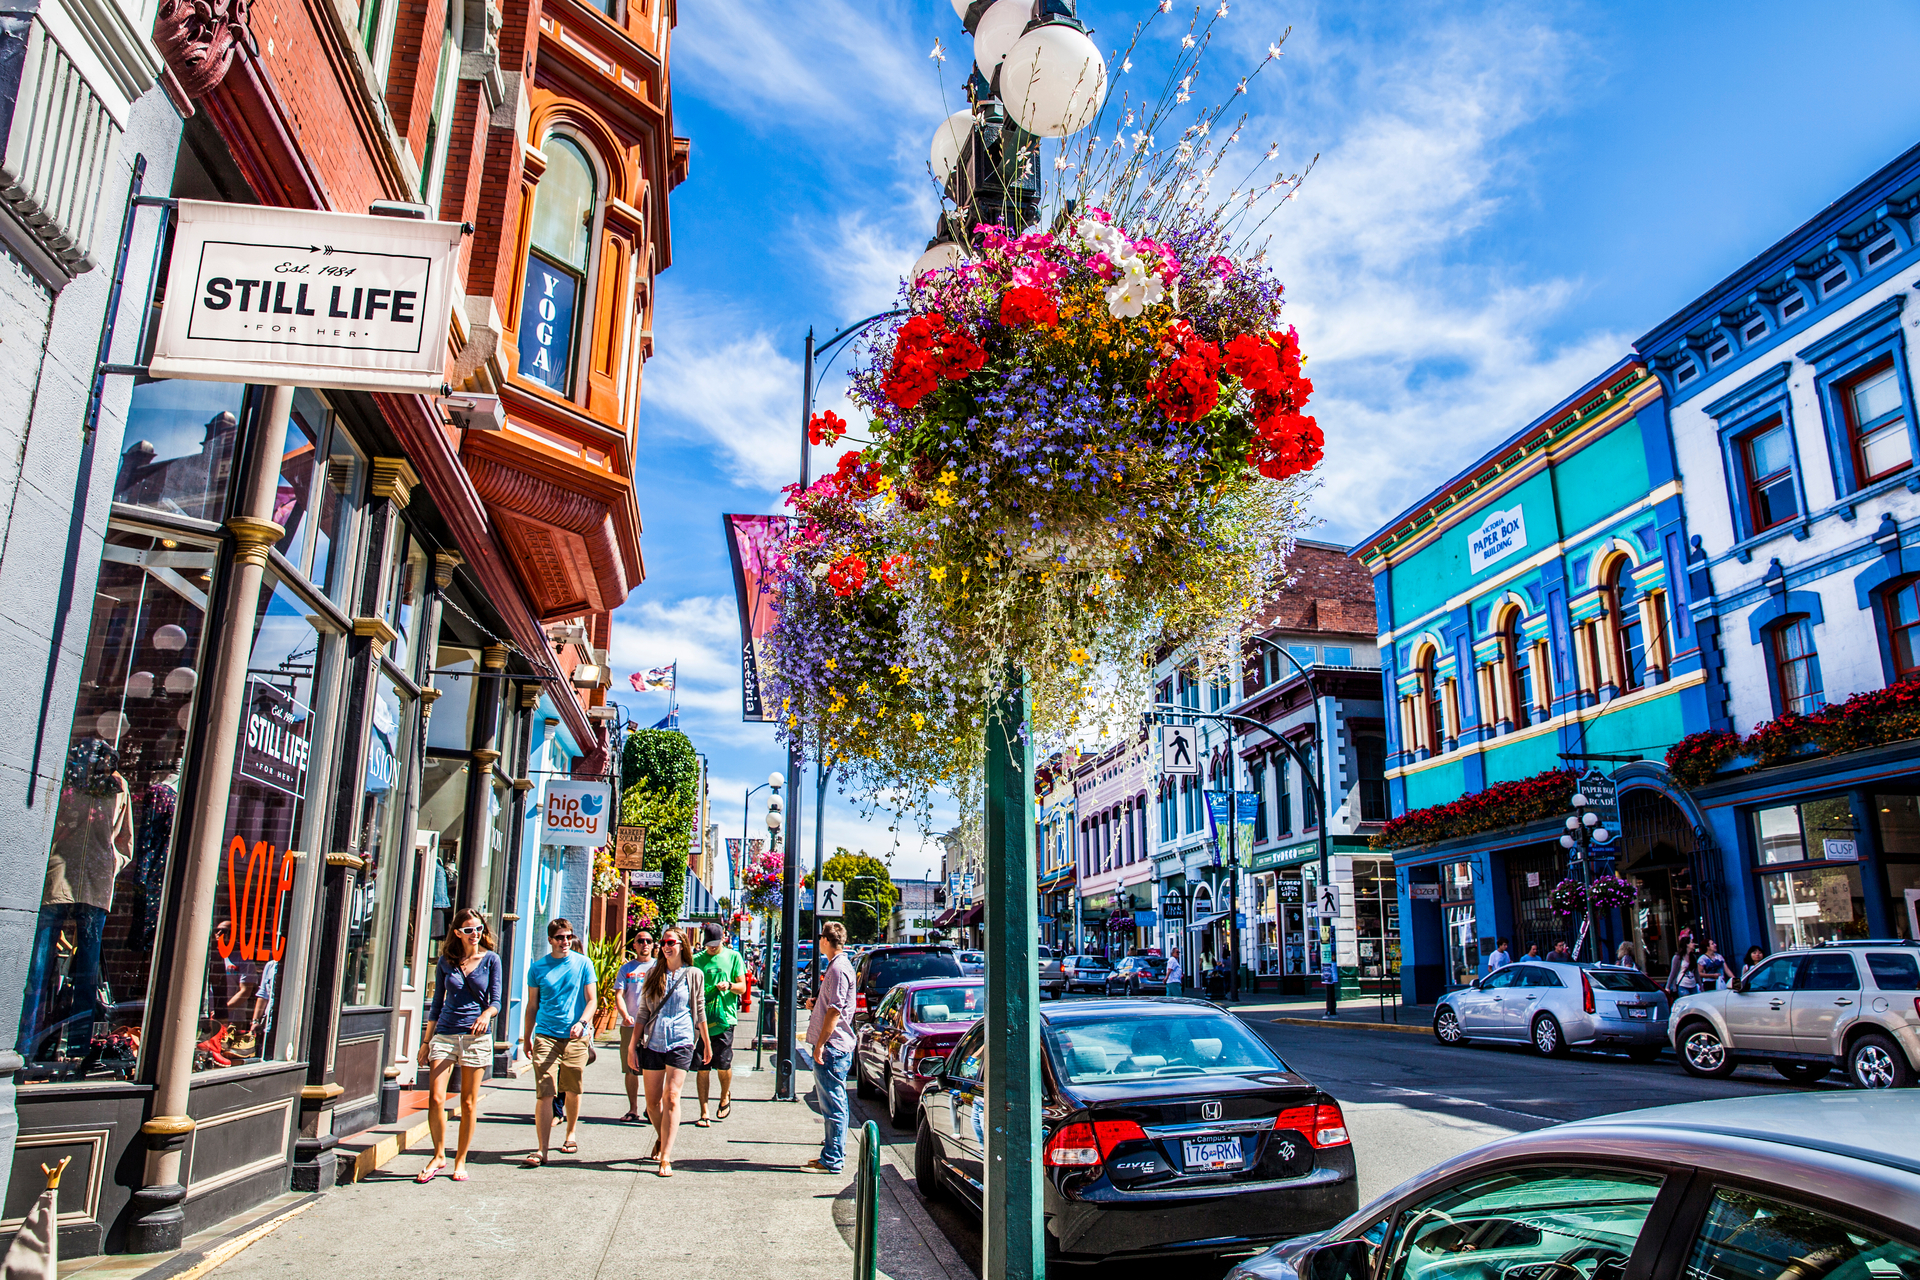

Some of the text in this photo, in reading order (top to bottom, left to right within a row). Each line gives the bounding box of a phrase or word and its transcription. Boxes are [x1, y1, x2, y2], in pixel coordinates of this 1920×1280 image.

[274, 261, 357, 278] Est. 1984
[203, 276, 417, 323] STILL LIFE
[256, 324, 357, 338] FOR HER
[532, 272, 560, 372] YOGA
[1473, 517, 1520, 554] PAPER BOX
[1482, 517, 1505, 535] VICTORIA
[1483, 536, 1513, 560] BUILDING
[743, 642, 758, 712] Victoria
[247, 713, 310, 772] STILL LIFE
[259, 763, 291, 782] FOR HER
[1581, 786, 1602, 794] PAPER
[548, 792, 580, 816] hip
[547, 810, 598, 835] baby
[619, 828, 643, 836] MARKET
[1828, 842, 1854, 855] CUSP
[1411, 887, 1439, 896] kazen
[1196, 1135, 1226, 1143] Campus
[1186, 1143, 1242, 1162] 176 RKN
[1116, 1161, 1155, 1169] CIVIC
